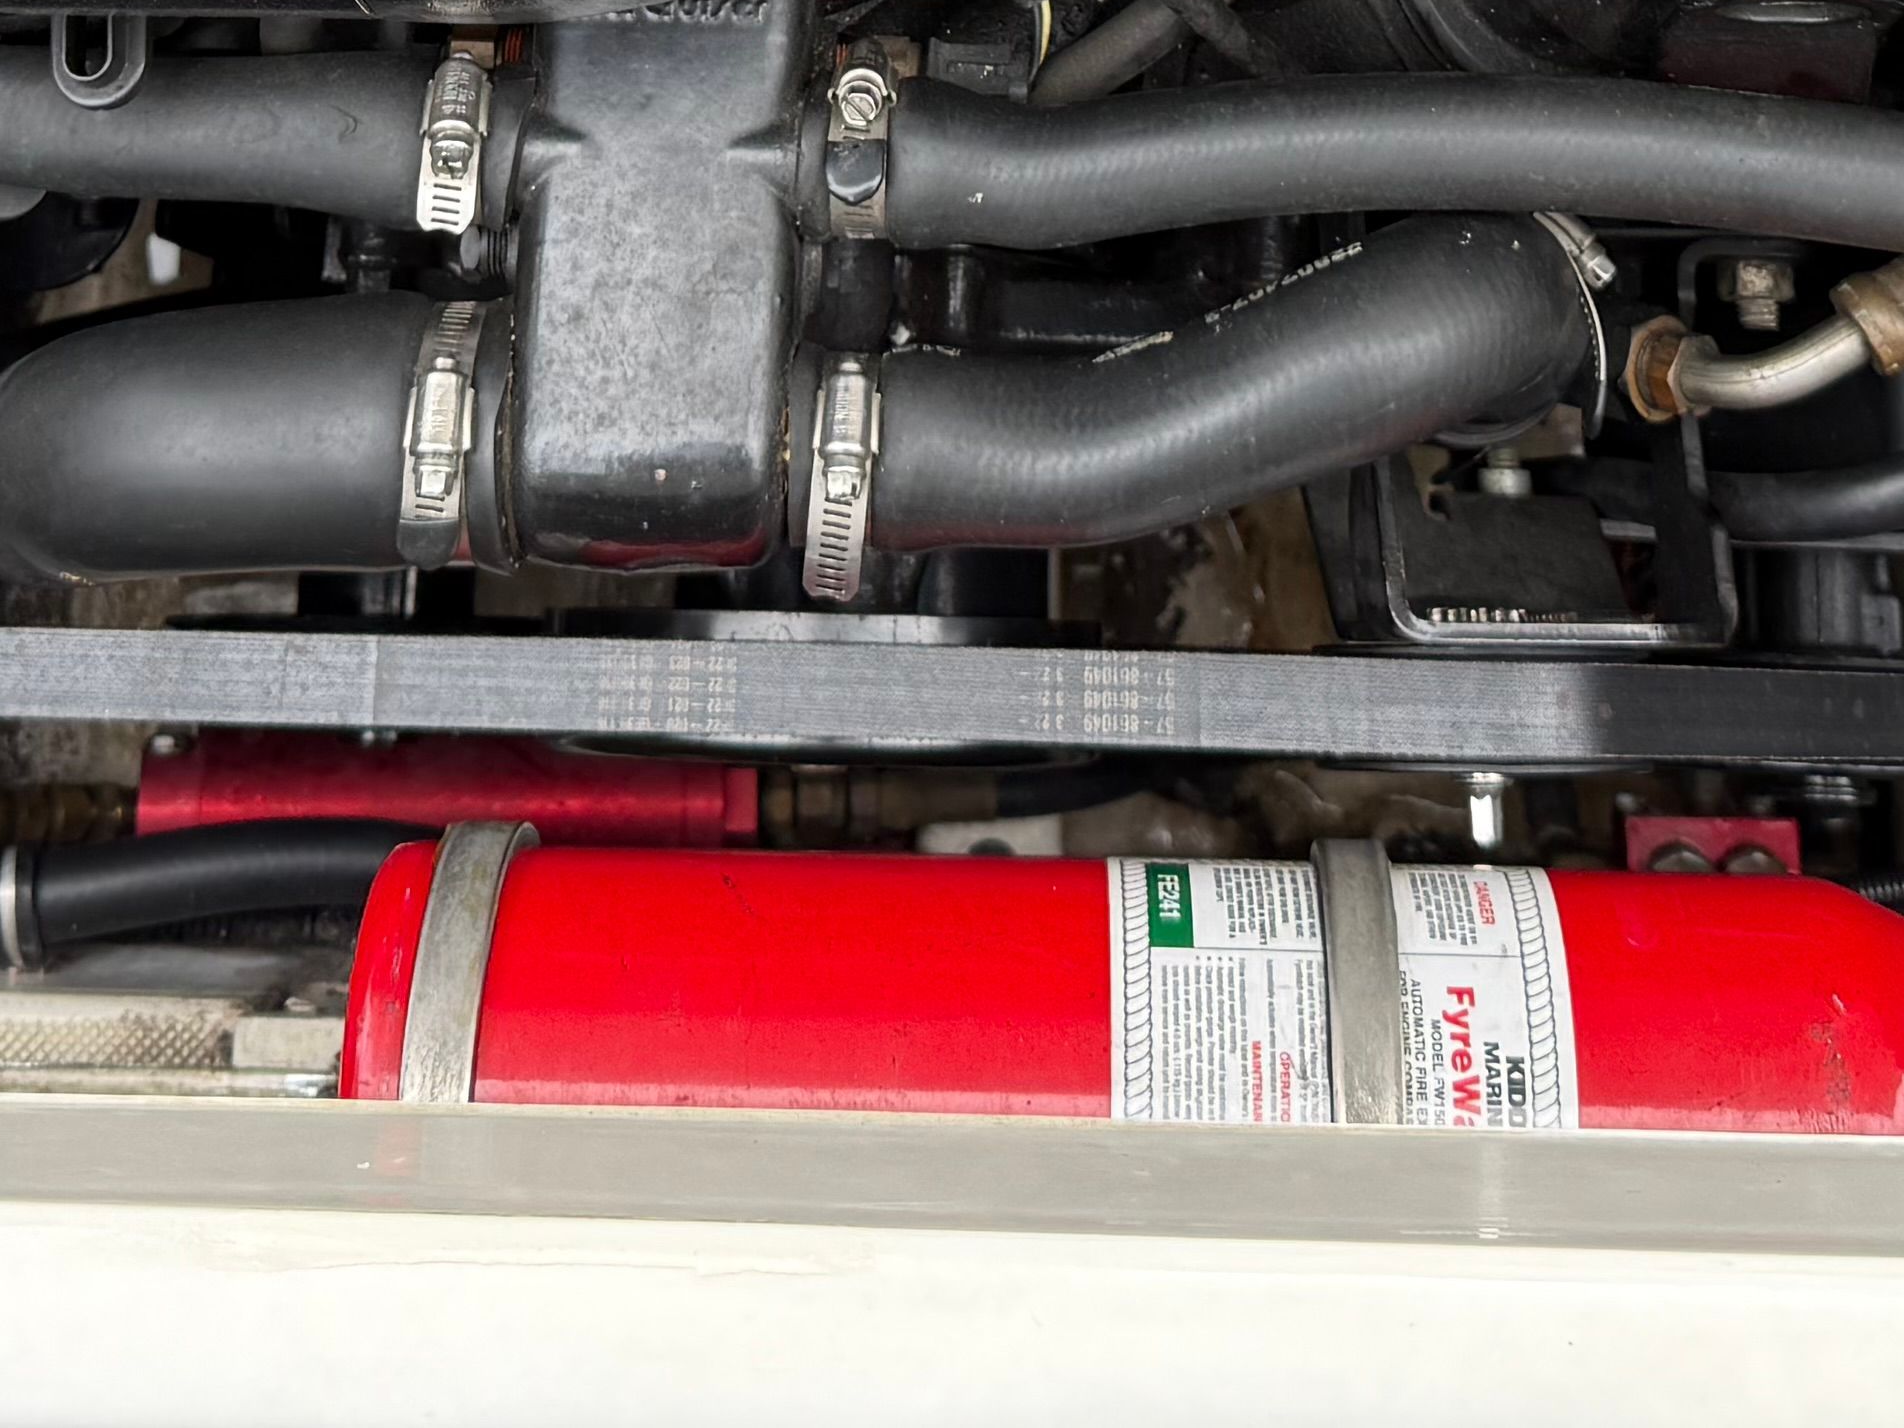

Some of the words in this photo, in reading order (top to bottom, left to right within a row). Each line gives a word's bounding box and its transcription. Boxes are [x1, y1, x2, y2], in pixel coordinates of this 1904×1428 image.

[1157, 873, 1184, 920] FE241
[1472, 880, 1496, 926] DANGER
[1410, 978, 1426, 1061] AUTOMATIC
[1431, 1018, 1444, 1072] MODEL
[1415, 1066, 1428, 1102] FIRE
